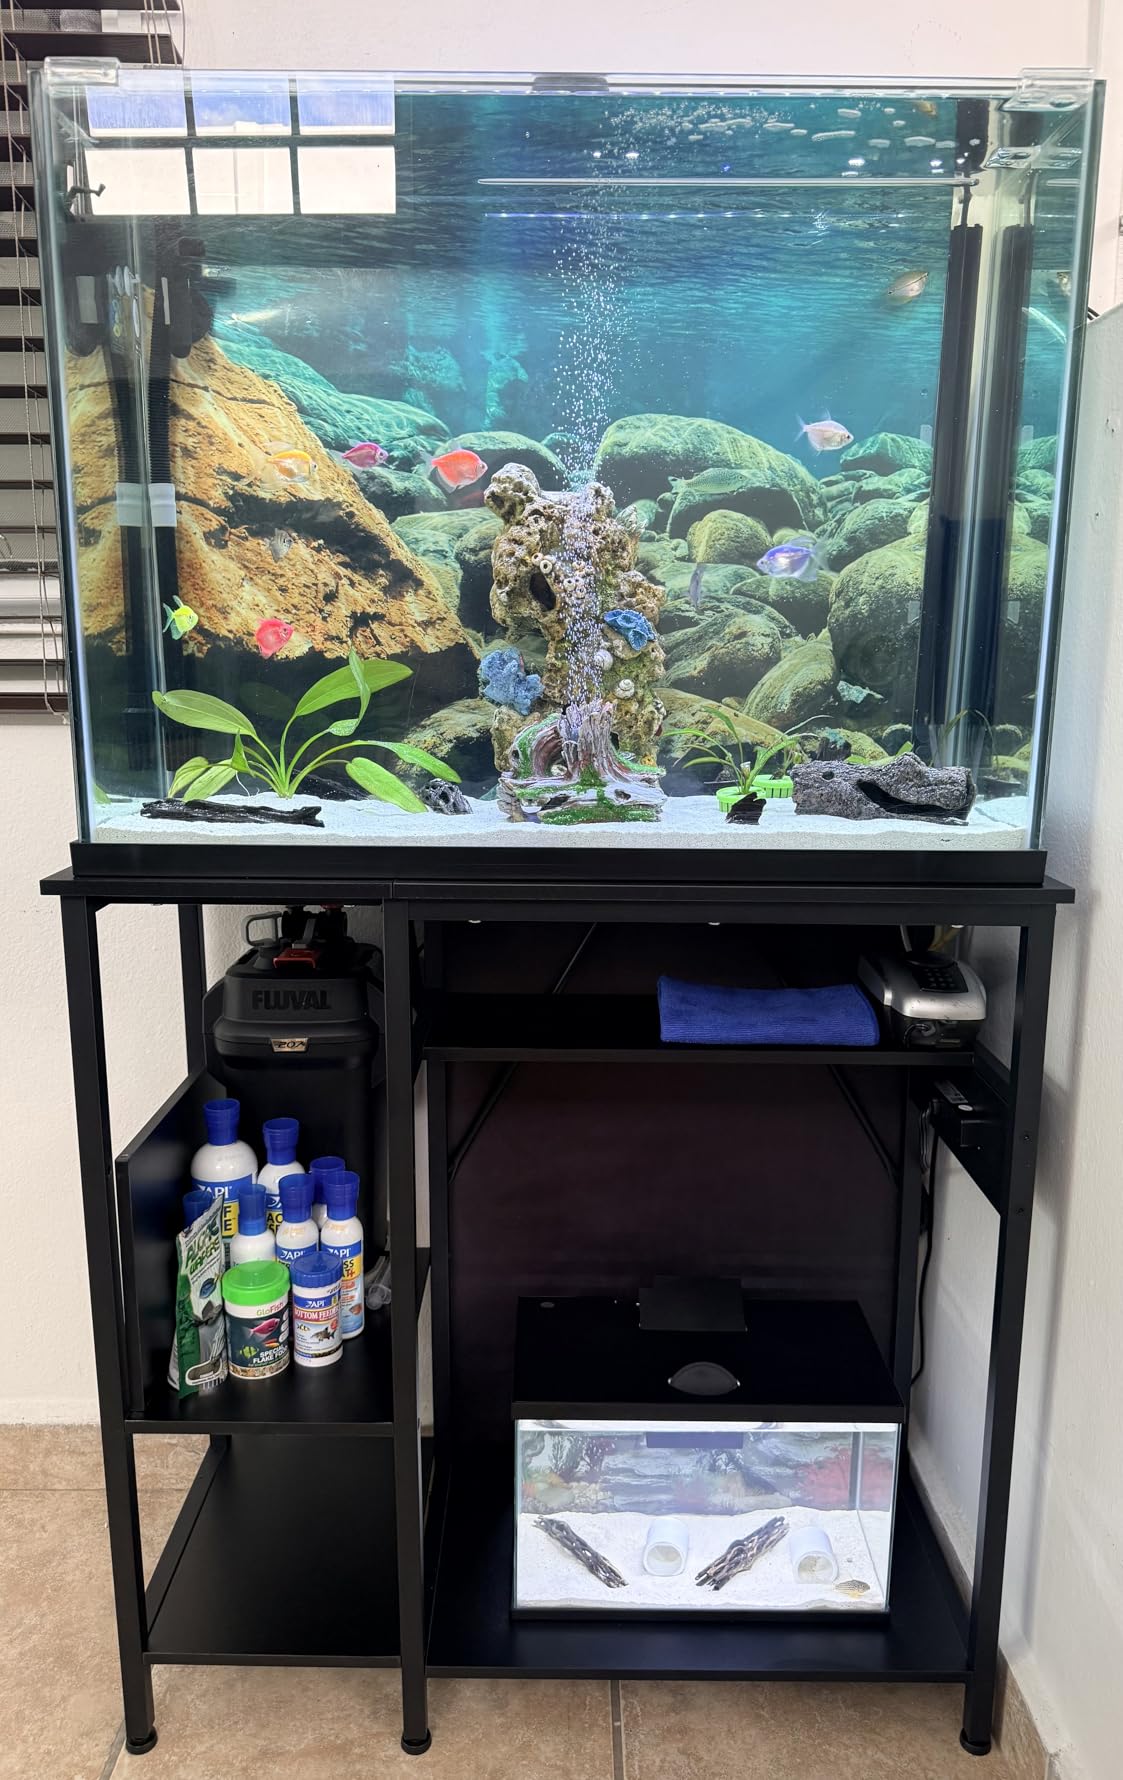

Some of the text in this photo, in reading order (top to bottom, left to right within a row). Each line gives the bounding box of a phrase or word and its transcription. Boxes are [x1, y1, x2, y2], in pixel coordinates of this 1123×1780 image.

[251, 990, 332, 1011] FLUVAL
[285, 1250, 304, 1260] API
[311, 1300, 325, 1308] API
[256, 1302, 284, 1317] GloFish
[253, 1355, 274, 1363] FLAKE
